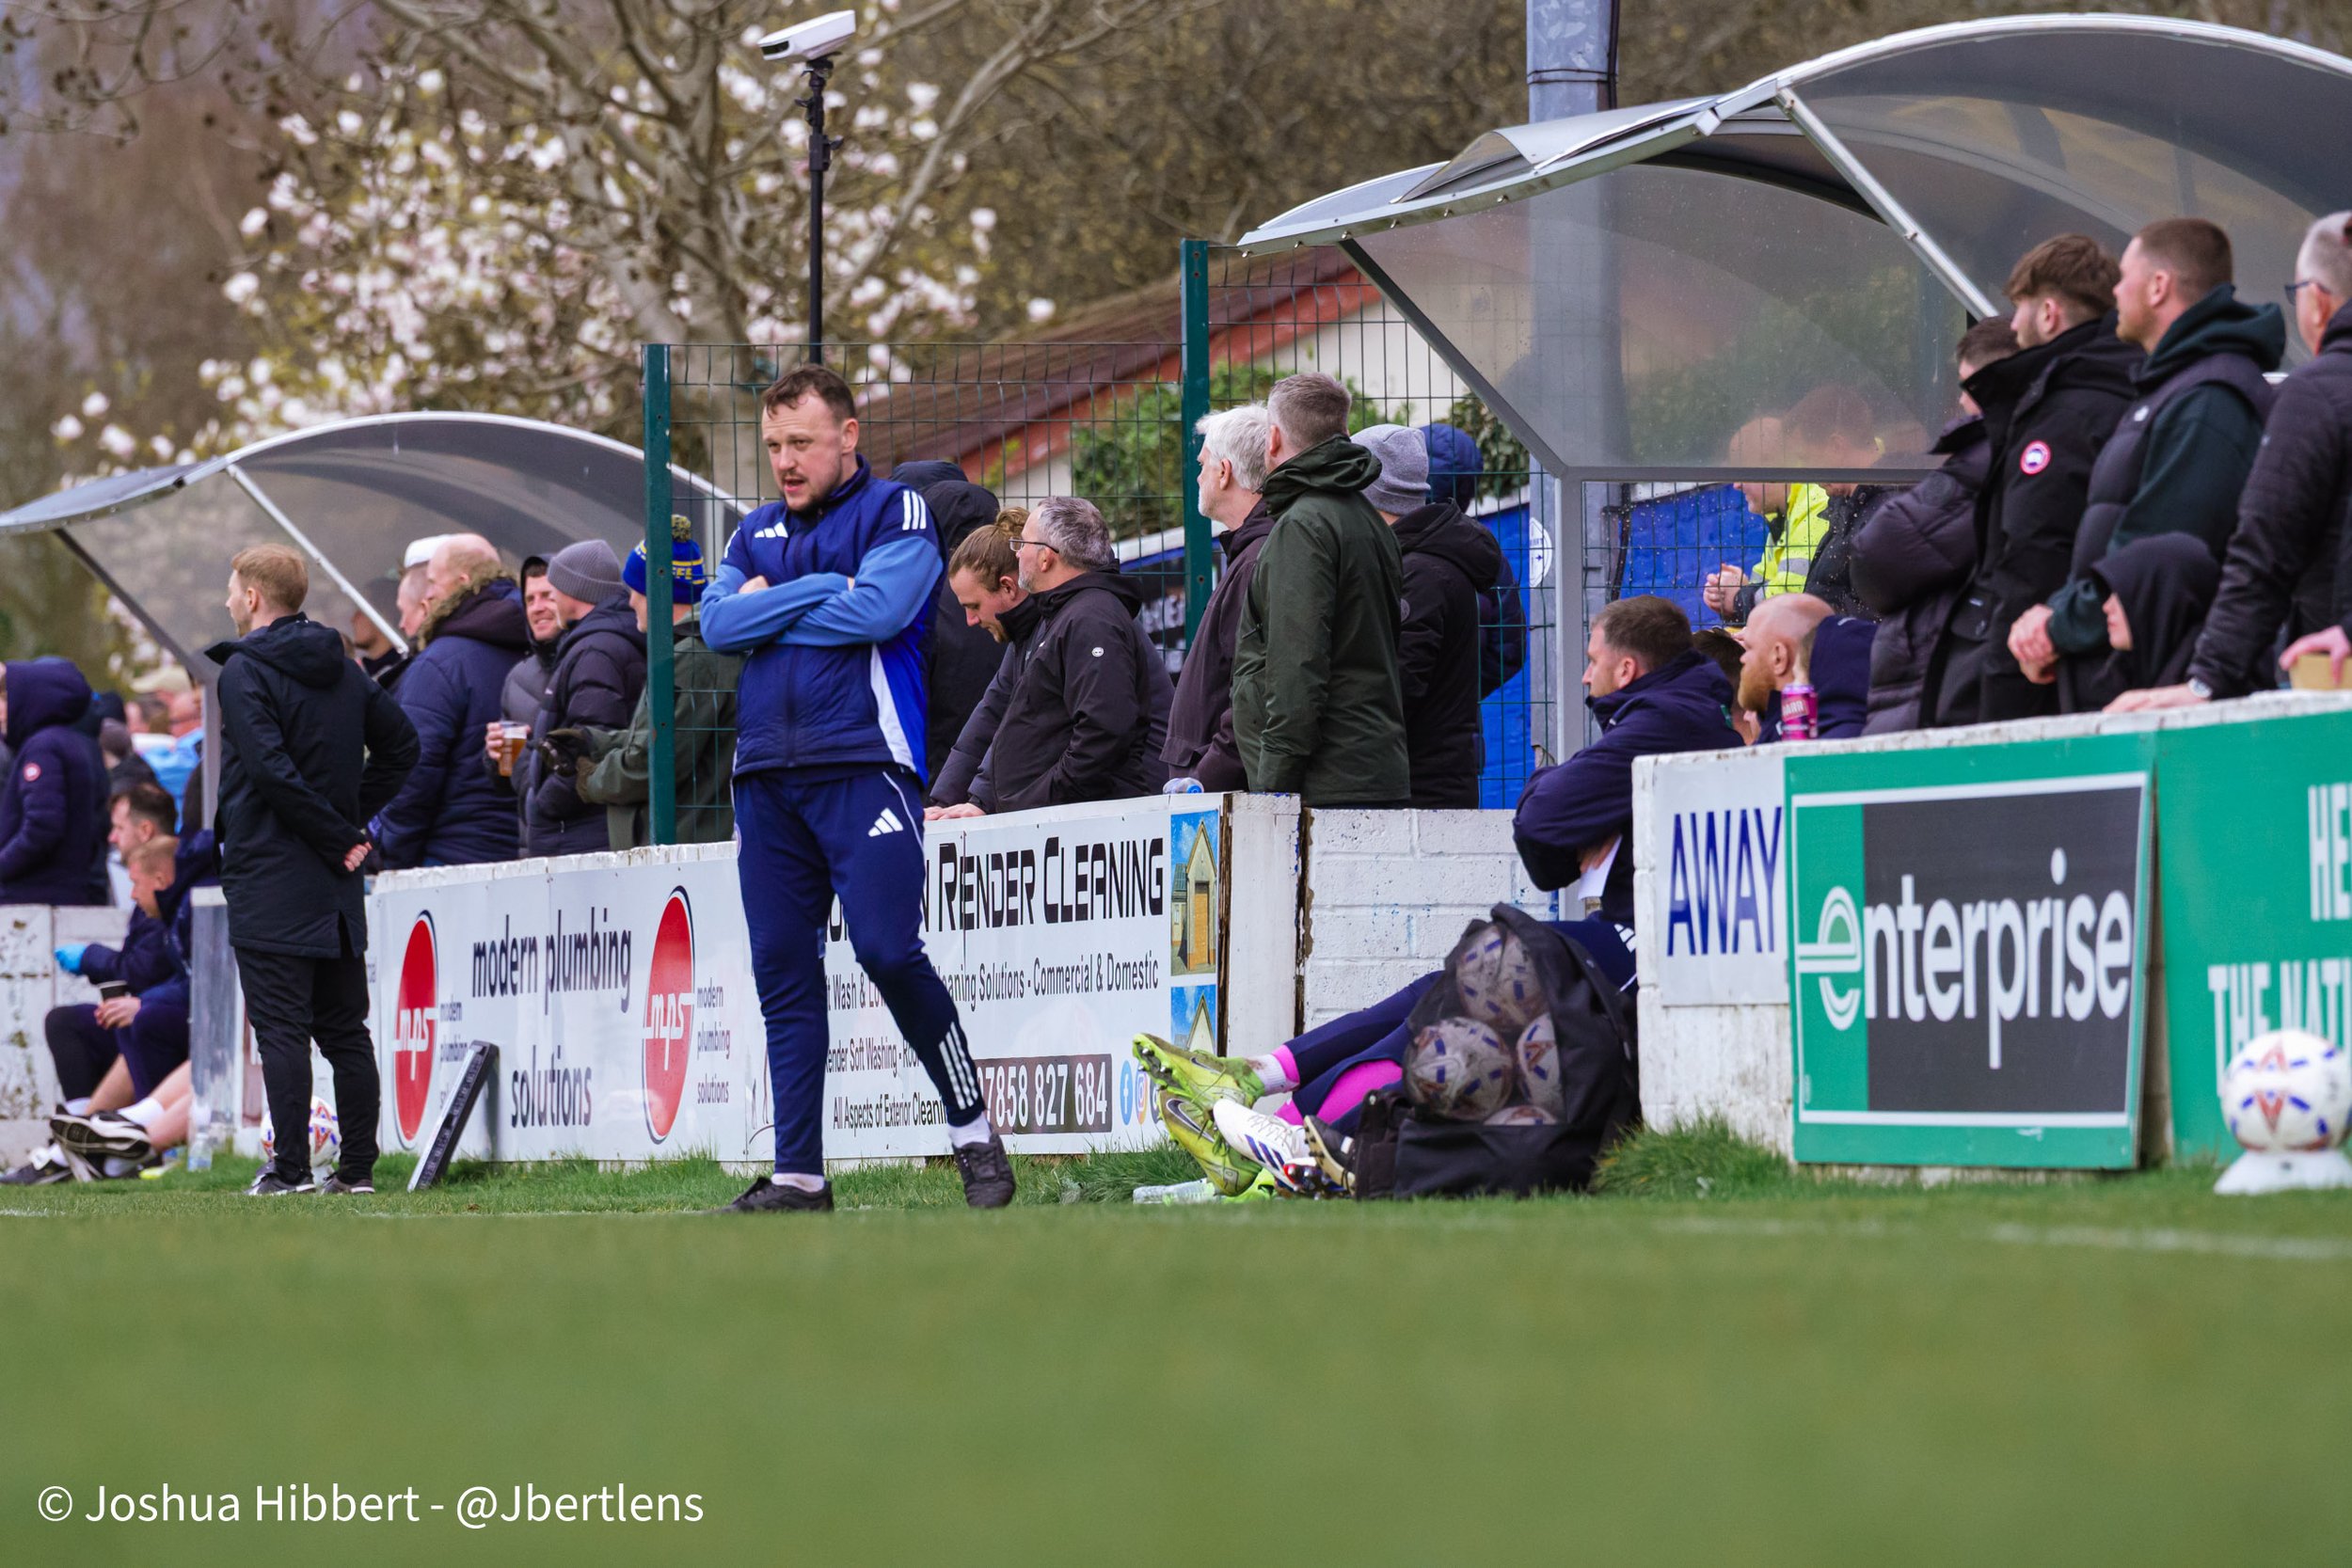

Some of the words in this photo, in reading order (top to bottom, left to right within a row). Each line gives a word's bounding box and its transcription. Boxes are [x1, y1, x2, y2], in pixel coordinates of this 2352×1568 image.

[1667, 806, 1783, 957] AWAY
[2308, 782, 2352, 921] HE
[472, 915, 537, 998] modern
[545, 907, 631, 1014] plumbing
[833, 974, 857, 1010] Wash
[859, 972, 866, 1008] &
[868, 980, 885, 1007] Lo
[932, 964, 976, 1012] aning
[979, 961, 1025, 1001] Solutions
[1034, 955, 1093, 996] Commercial
[1096, 953, 1104, 992] &
[1106, 950, 1159, 991] Domestic
[1798, 847, 2132, 1069] enterprise
[696, 977, 723, 1008] modern
[697, 1022, 730, 1060] plumbing
[825, 1039, 848, 1073] ender
[850, 1037, 866, 1072] Soft
[866, 1036, 898, 1078] Washing
[511, 1046, 593, 1129] solutions
[697, 1073, 729, 1104] solutions
[834, 1096, 843, 1130] All
[845, 1096, 874, 1137] Aspects
[875, 1094, 883, 1128] of
[884, 1093, 911, 1127] Exterior
[1035, 1063, 1068, 1127] 827
[1074, 1061, 1107, 1126] 684
